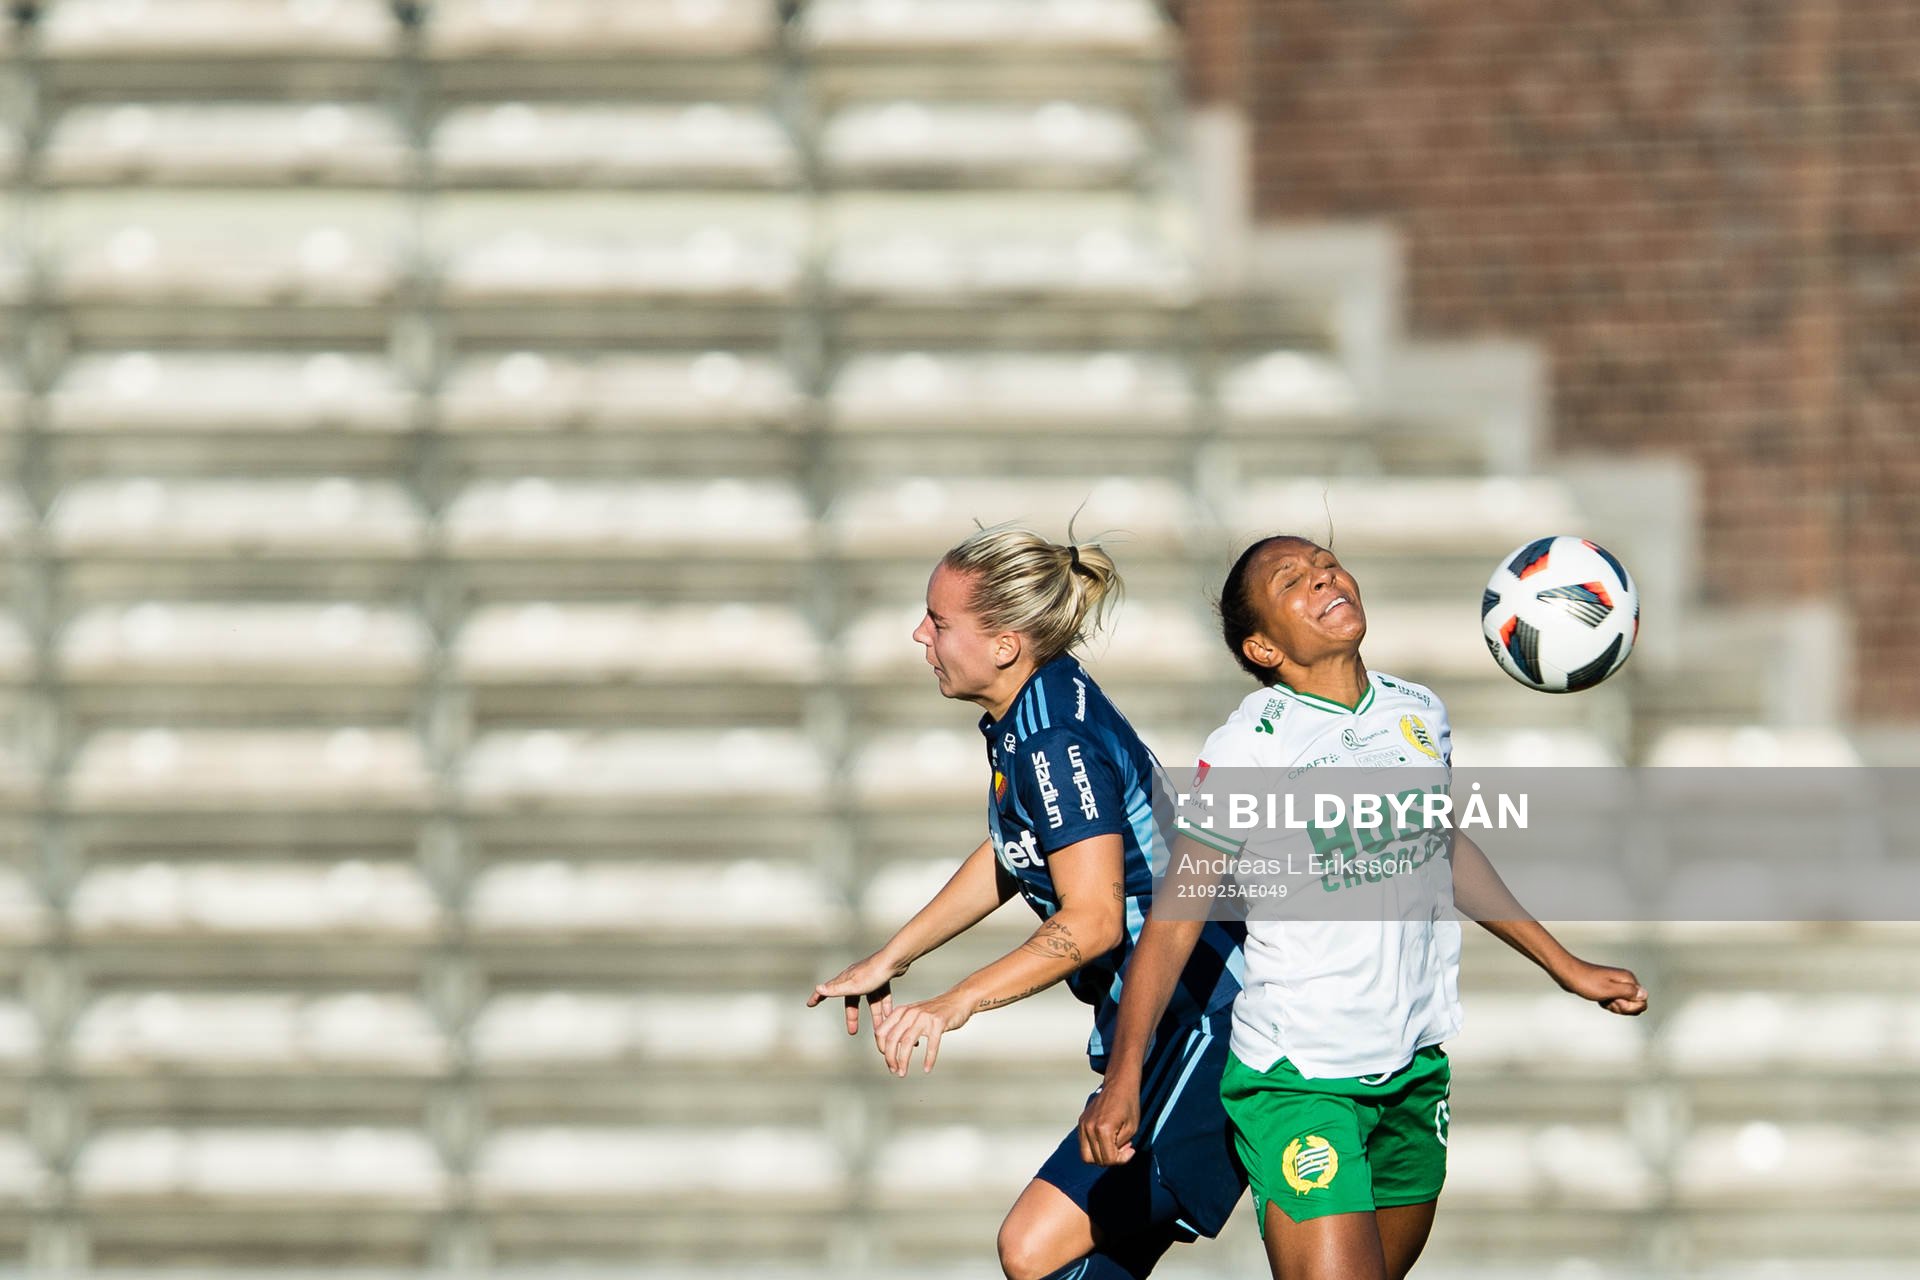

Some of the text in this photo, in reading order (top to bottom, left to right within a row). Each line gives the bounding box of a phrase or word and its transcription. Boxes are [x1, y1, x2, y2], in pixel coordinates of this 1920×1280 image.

[1031, 751, 1063, 829] stadium
[1067, 744, 1099, 820] stadium
[1288, 756, 1328, 780] CRAFT
